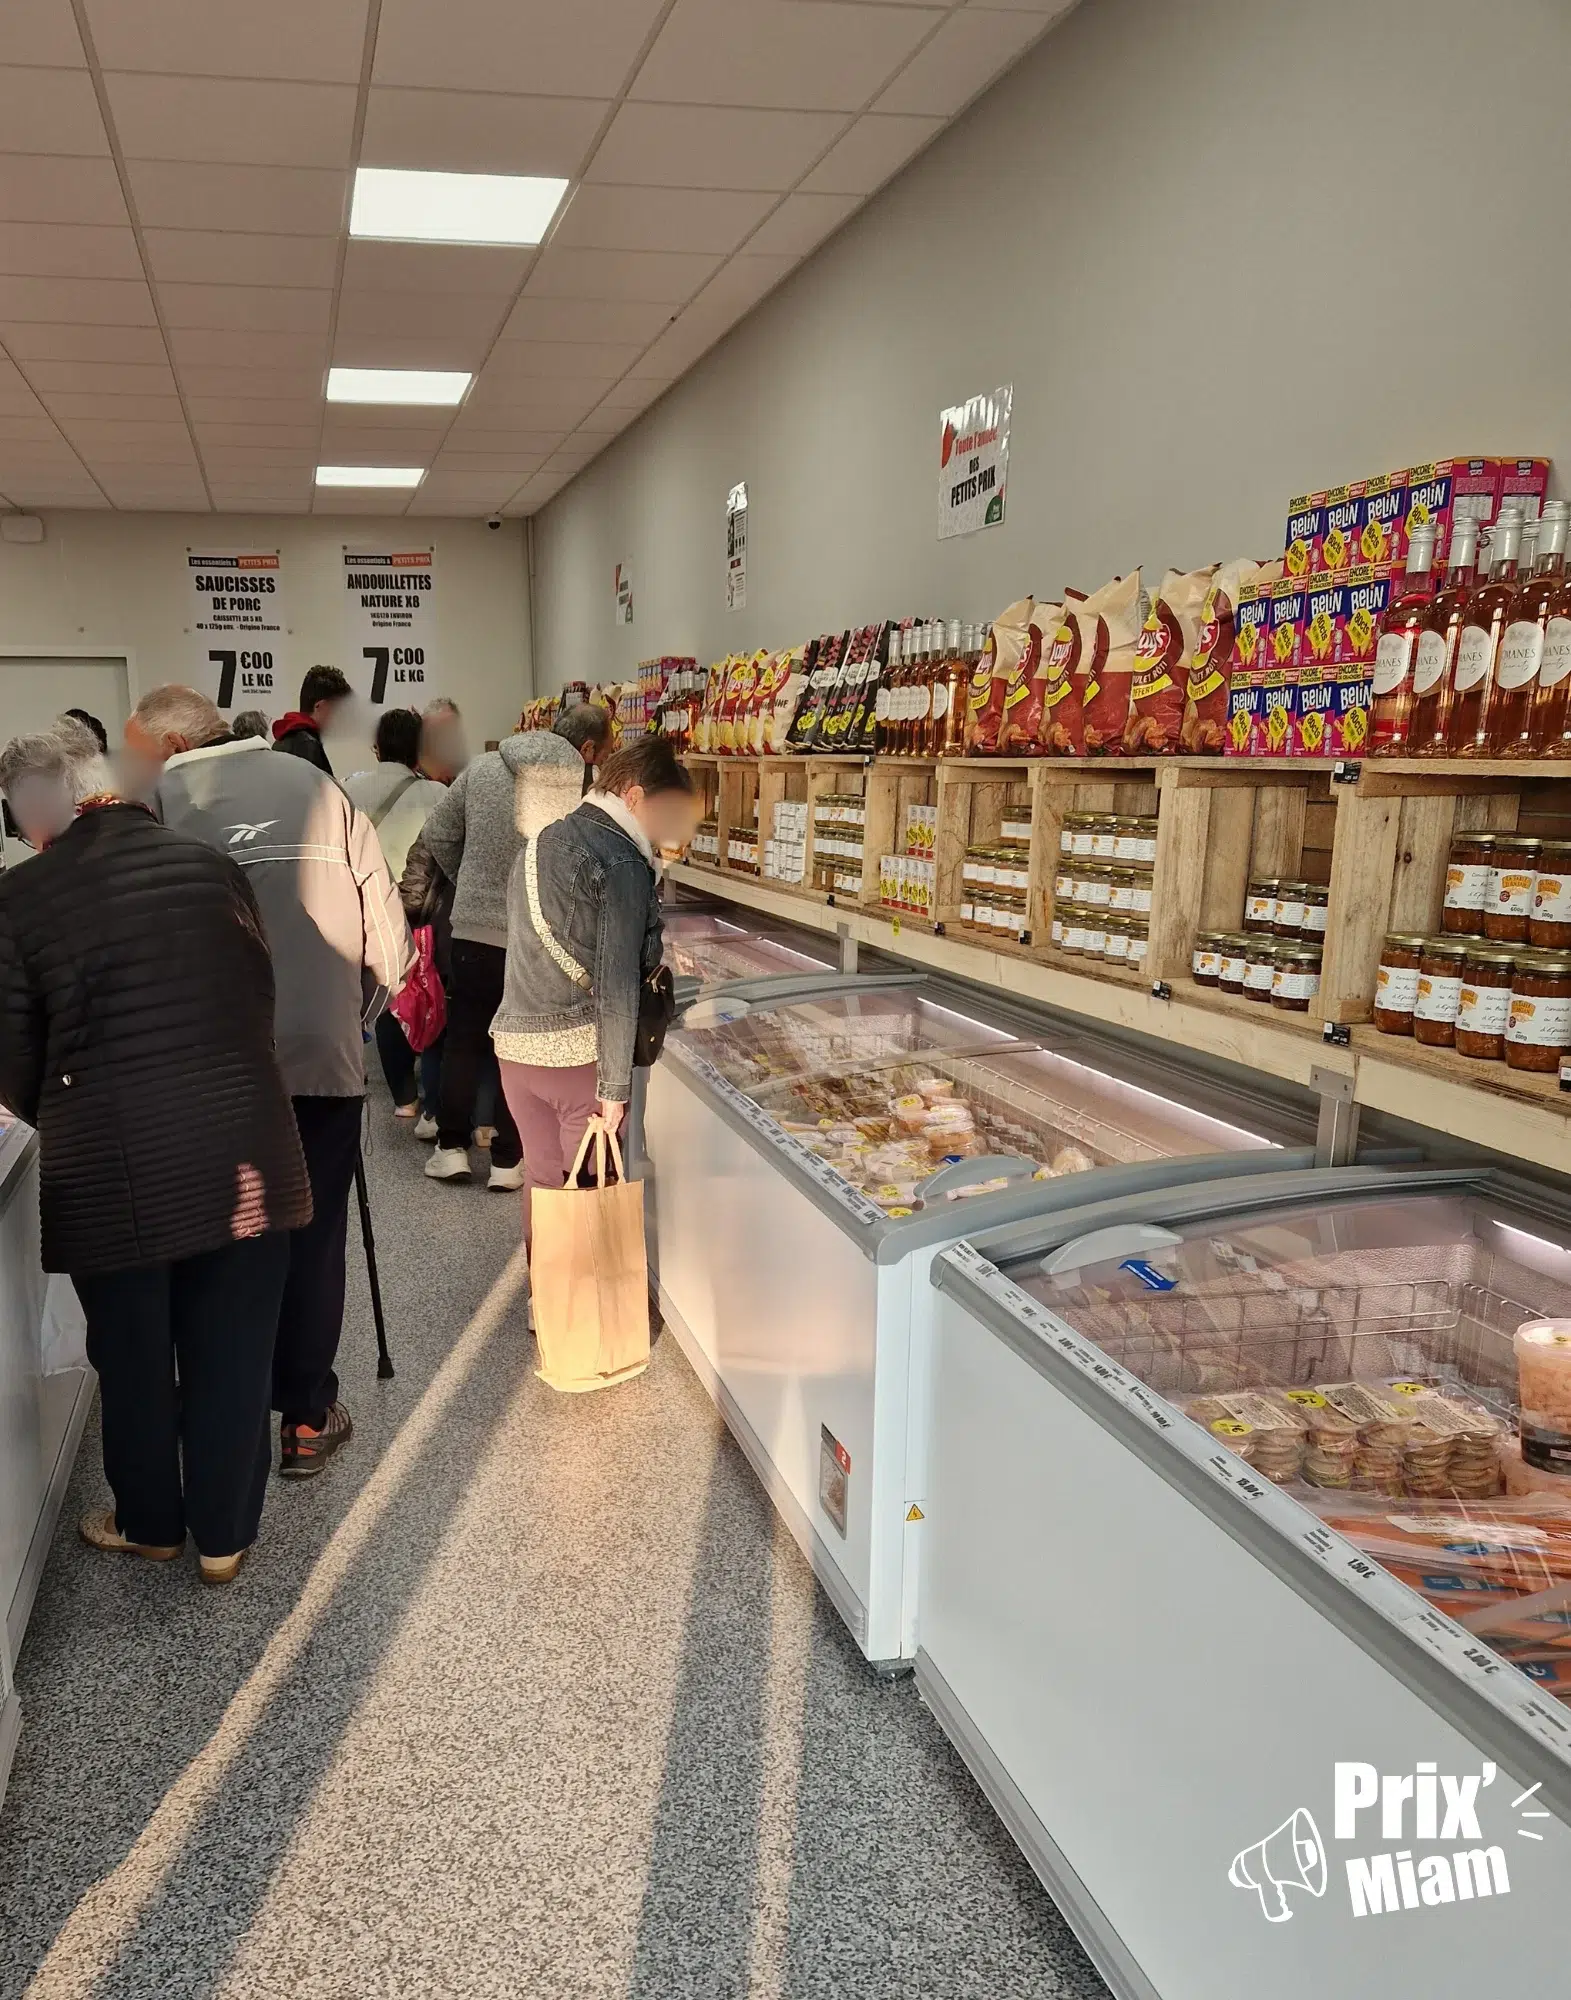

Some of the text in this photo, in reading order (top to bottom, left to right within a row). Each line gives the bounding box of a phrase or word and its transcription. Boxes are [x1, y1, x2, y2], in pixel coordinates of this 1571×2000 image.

[969, 456, 980, 475] DES
[1411, 465, 1430, 476] ENCORE
[951, 465, 996, 508] PETITS PRIX
[1367, 476, 1385, 487] ENCORE
[1310, 573, 1328, 583] ENCORE
[1350, 566, 1370, 577] ENCORE
[196, 575, 276, 593] SAUCISSES
[348, 574, 431, 590] ANDOUILLETTES
[212, 597, 261, 611] DE PORC
[361, 595, 420, 608] NATURE X8
[240, 623, 260, 631] Origine
[240, 651, 272, 669] €00
[363, 647, 389, 704] 7
[394, 670, 424, 682] LE KG
[1339, 665, 1357, 674] ENCORE
[209, 650, 236, 708] 7
[242, 674, 273, 686] LE KG
